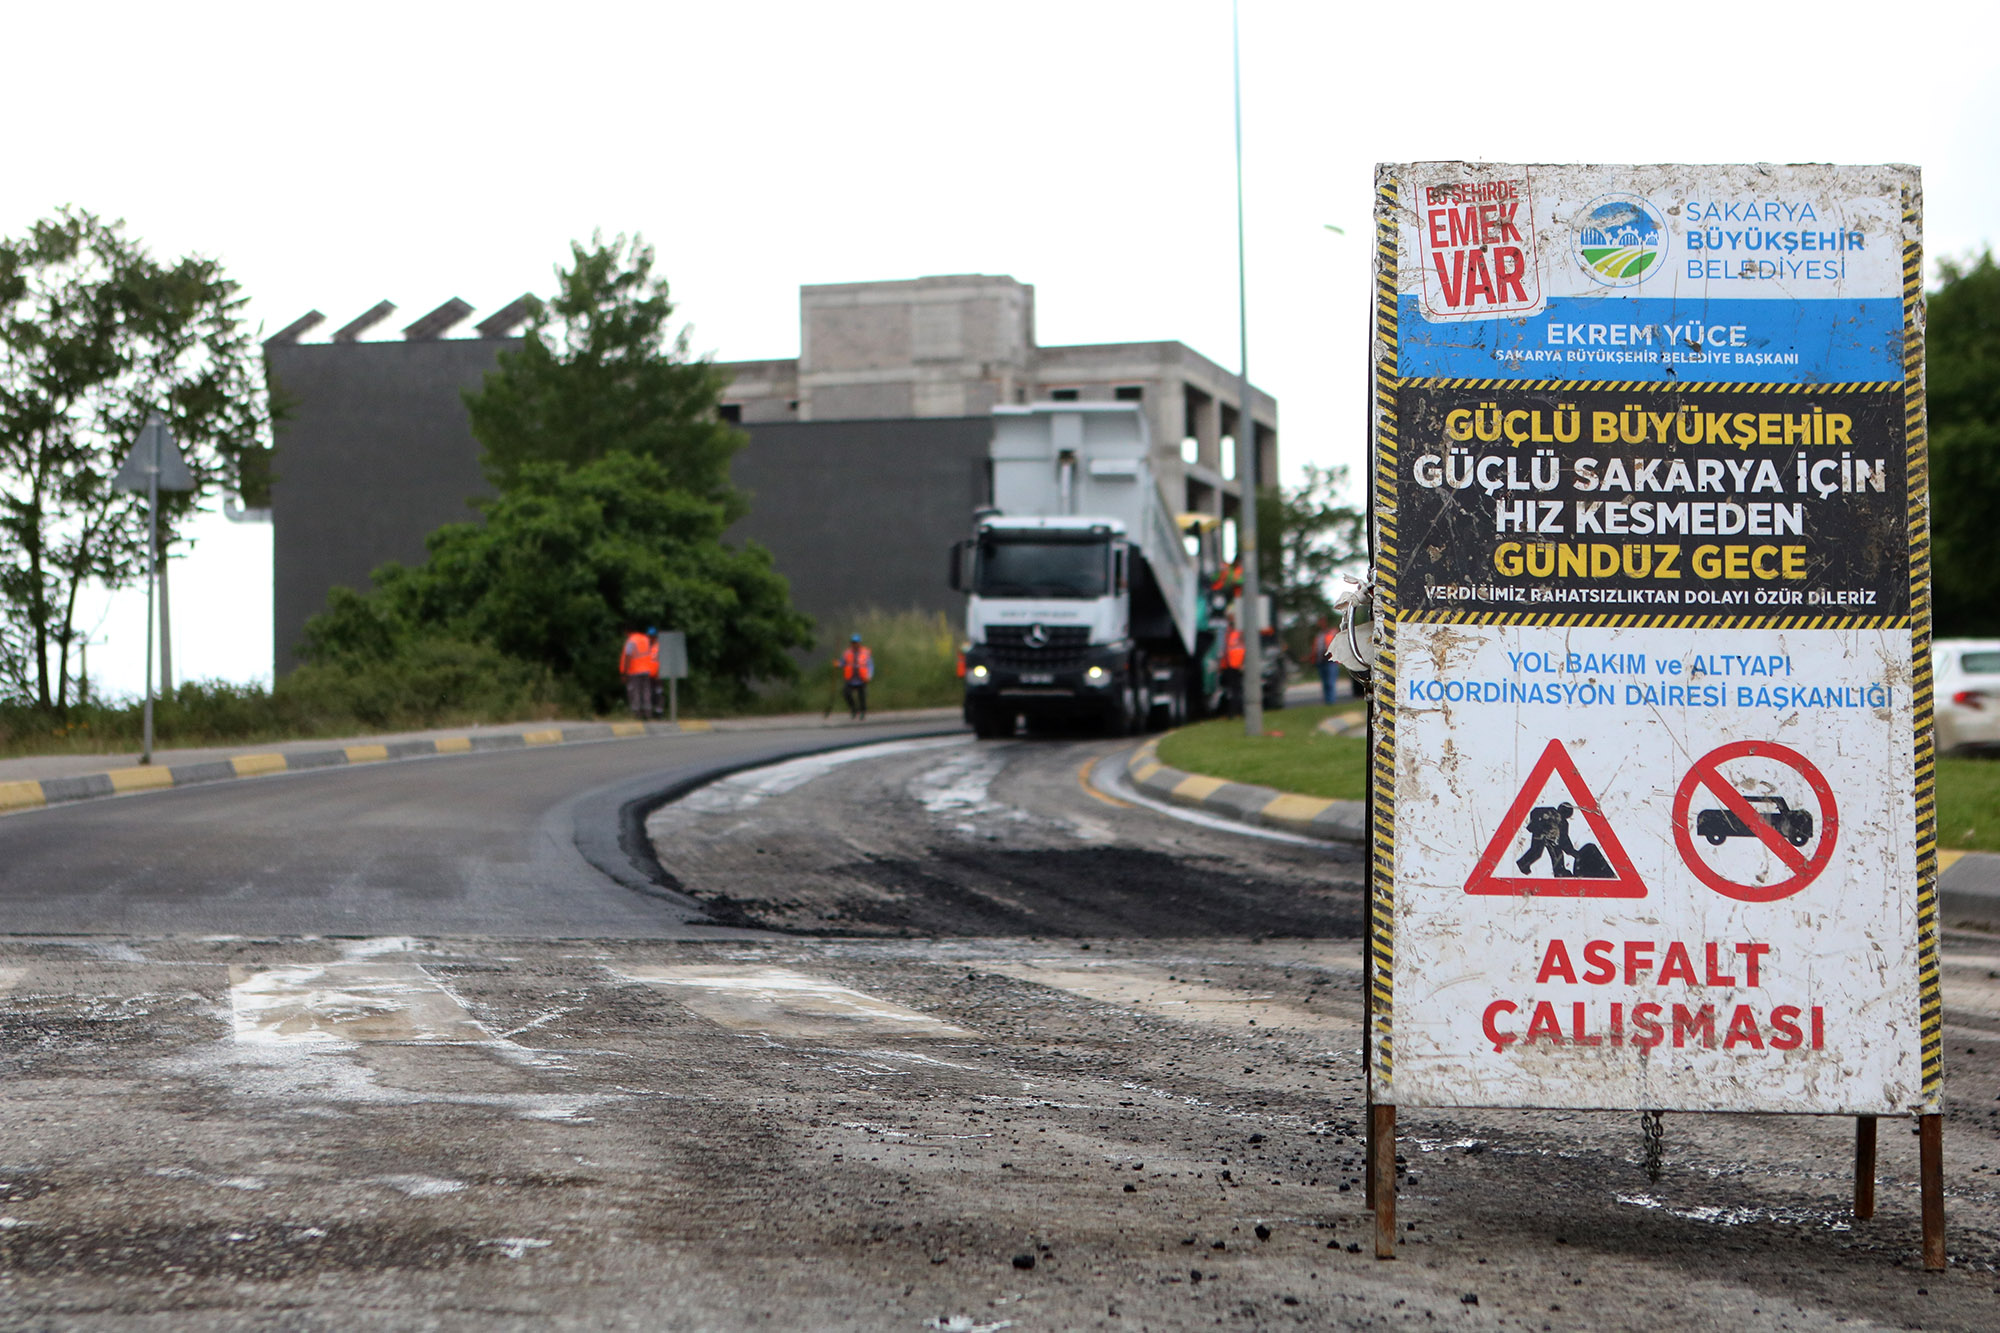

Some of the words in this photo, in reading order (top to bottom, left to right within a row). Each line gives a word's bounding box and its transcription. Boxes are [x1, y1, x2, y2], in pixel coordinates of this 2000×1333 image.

[1427, 202, 1523, 249] EMEK
[1686, 202, 1818, 222] SAKARYA
[1687, 226, 1865, 254] BÜYÜKŞEHİR
[1432, 246, 1529, 307] VAR
[1687, 256, 1846, 280] BELEDİYESİ
[1547, 323, 1651, 345] EKREM
[1663, 320, 1747, 347] YÜCE
[1496, 349, 1562, 362] SAKARYA
[1567, 348, 1658, 366] BÜYÜKŞEHİR
[1662, 350, 1731, 364] BELEDİYE
[1734, 353, 1799, 366] BAŞKANI
[1445, 402, 1581, 448] GÜÇLÜ
[1592, 404, 1853, 451] BÜYÜKŞEHİR
[1413, 447, 1560, 497] GÜÇLÜ
[1573, 457, 1784, 494] SAKARYA
[1797, 452, 1886, 499] İÇİN
[1496, 500, 1564, 534] HIZ
[1576, 501, 1804, 535] KESMEDEN
[1494, 542, 1681, 579] GÜNDÜZ
[1692, 544, 1807, 580] GECE
[1531, 588, 1679, 604] RAHATSIZLIKTAN
[1685, 590, 1749, 605] DOLAYI
[1754, 587, 1803, 605] ÖZÜR
[1808, 588, 1876, 605] DİLERİZ
[1508, 652, 1556, 673] YOL
[1566, 653, 1646, 675] BAKIM
[1655, 659, 1682, 675] ve
[1691, 654, 1791, 677] ALTYAPI
[1410, 678, 1615, 706] KOORDİNASYON
[1626, 681, 1726, 707] DAİRESİ
[1737, 682, 1893, 711] BAŞKANLIĞI
[1536, 939, 1770, 988] ASFALT
[1482, 999, 1825, 1056] ÇALIŞMASI
